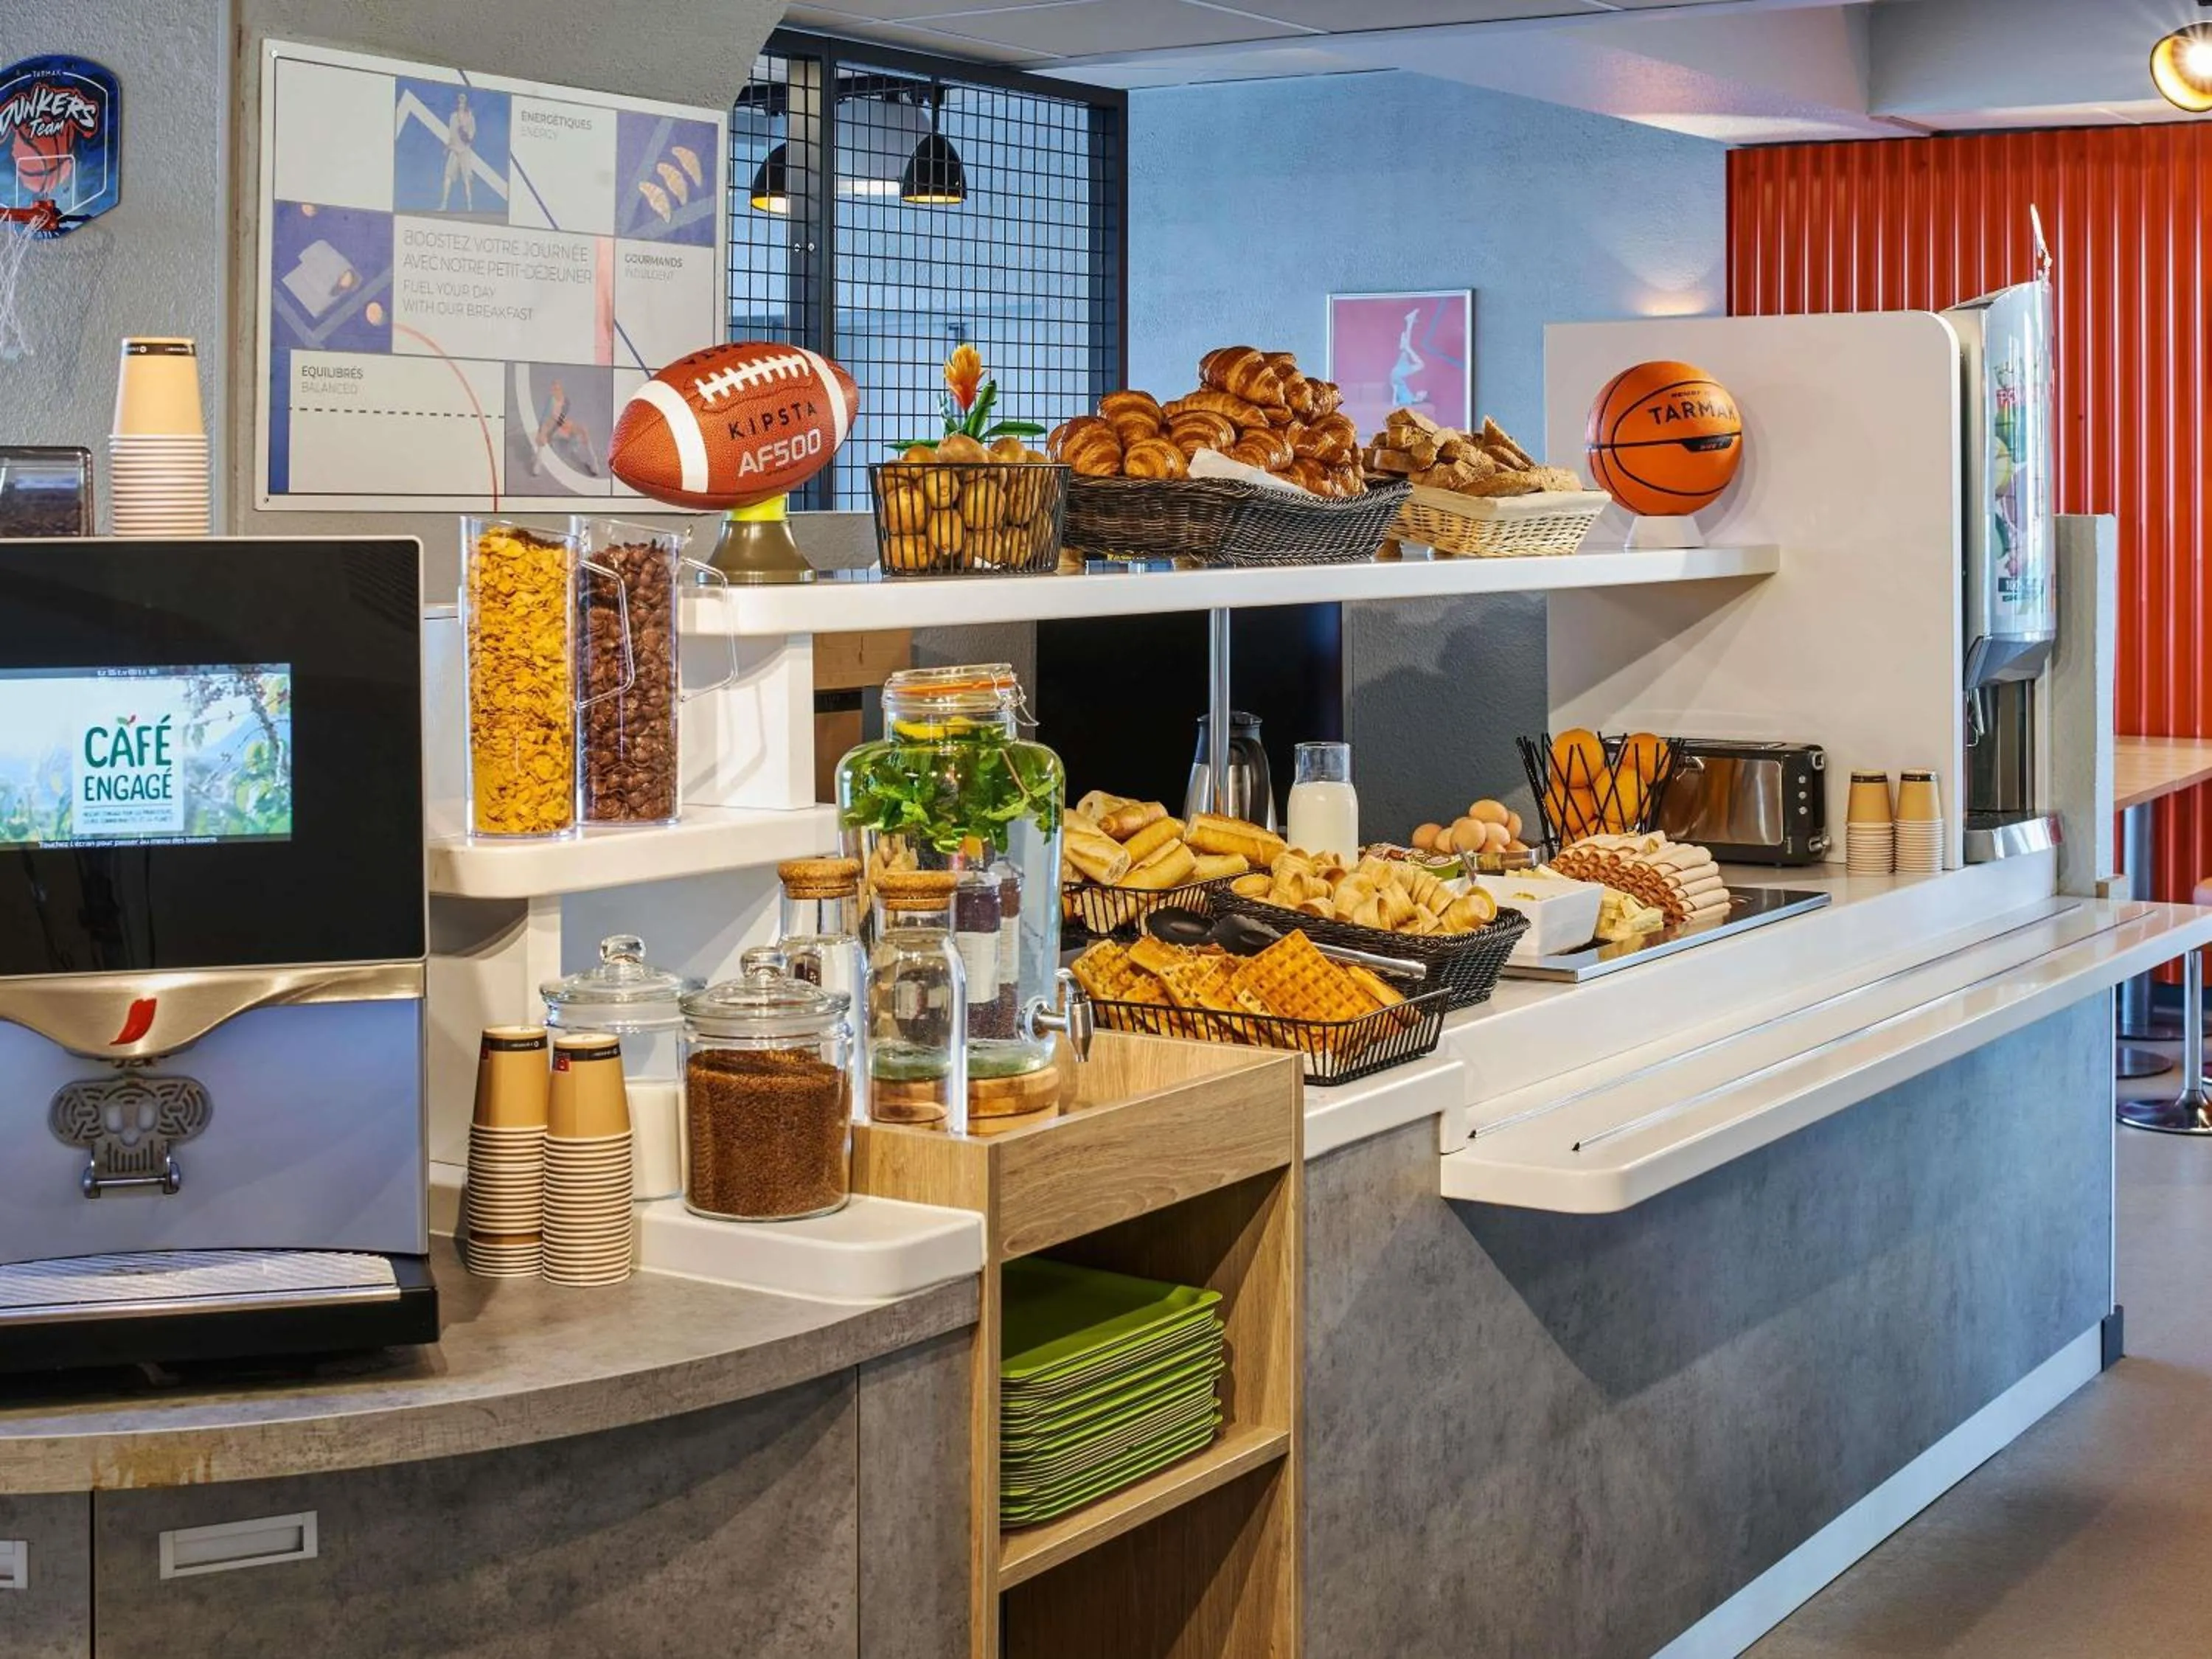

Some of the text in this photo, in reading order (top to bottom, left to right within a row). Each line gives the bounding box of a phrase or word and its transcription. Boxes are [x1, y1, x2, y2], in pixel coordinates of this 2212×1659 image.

[403, 229, 471, 251] BOOSTEZ
[473, 237, 523, 256] VOTRE
[403, 254, 439, 271] AVEC
[439, 258, 485, 276] NOTRE
[625, 253, 683, 268] GOURMANDS
[403, 279, 434, 295] FUEL
[472, 285, 496, 299] DAY
[402, 299, 533, 320] WITH OUR BREAKFAST
[728, 401, 817, 440] KIPSTA
[738, 428, 821, 477] AF500
[85, 713, 172, 768] CAFÉ
[84, 767, 173, 801] ENGAGÉ
